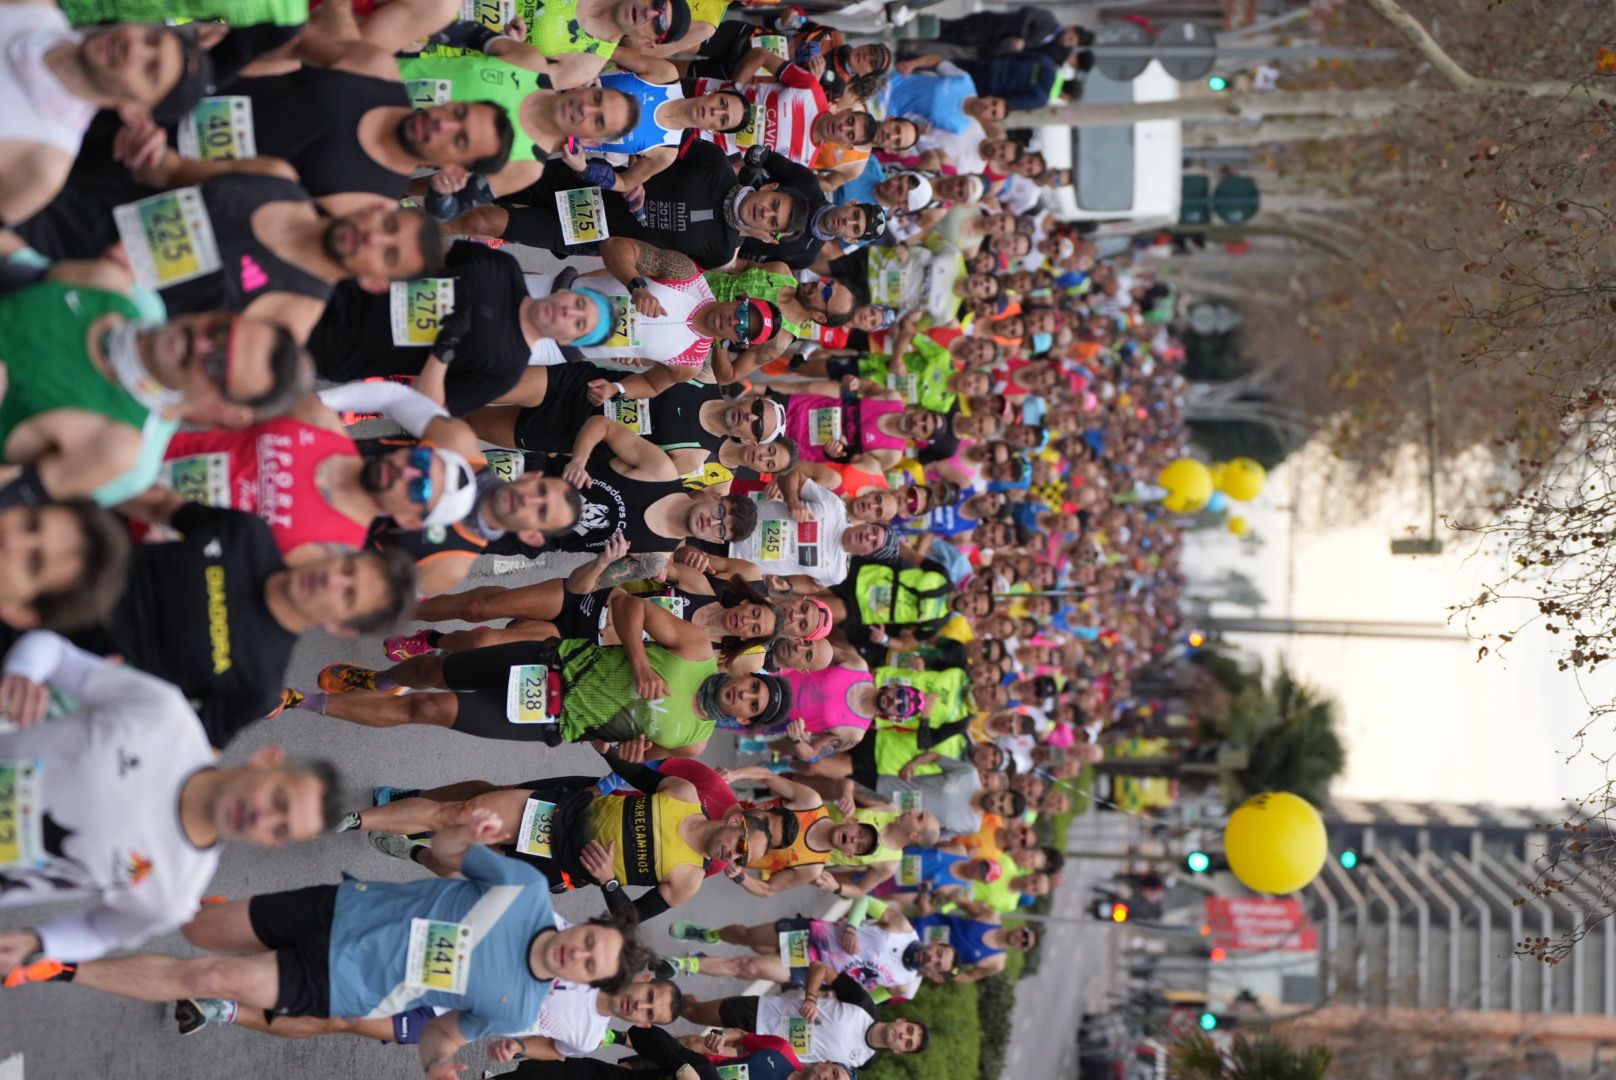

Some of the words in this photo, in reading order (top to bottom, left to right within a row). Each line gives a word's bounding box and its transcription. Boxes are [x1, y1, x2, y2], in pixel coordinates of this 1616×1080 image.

[567, 194, 577, 219] RAMON
[575, 200, 595, 232] 175
[659, 201, 668, 231] 2015
[676, 202, 688, 232] mim
[152, 206, 193, 263] 225
[571, 220, 580, 239] BORT
[415, 291, 437, 331] 275
[274, 434, 294, 530] SPORT
[591, 479, 626, 518] omadores
[766, 528, 780, 553] 245
[205, 565, 232, 675] DIADORA
[525, 677, 542, 711] 238
[529, 813, 540, 842] CANTOS
[535, 813, 554, 844] 393
[431, 936, 454, 976] 441
[793, 1025, 805, 1047] 313
